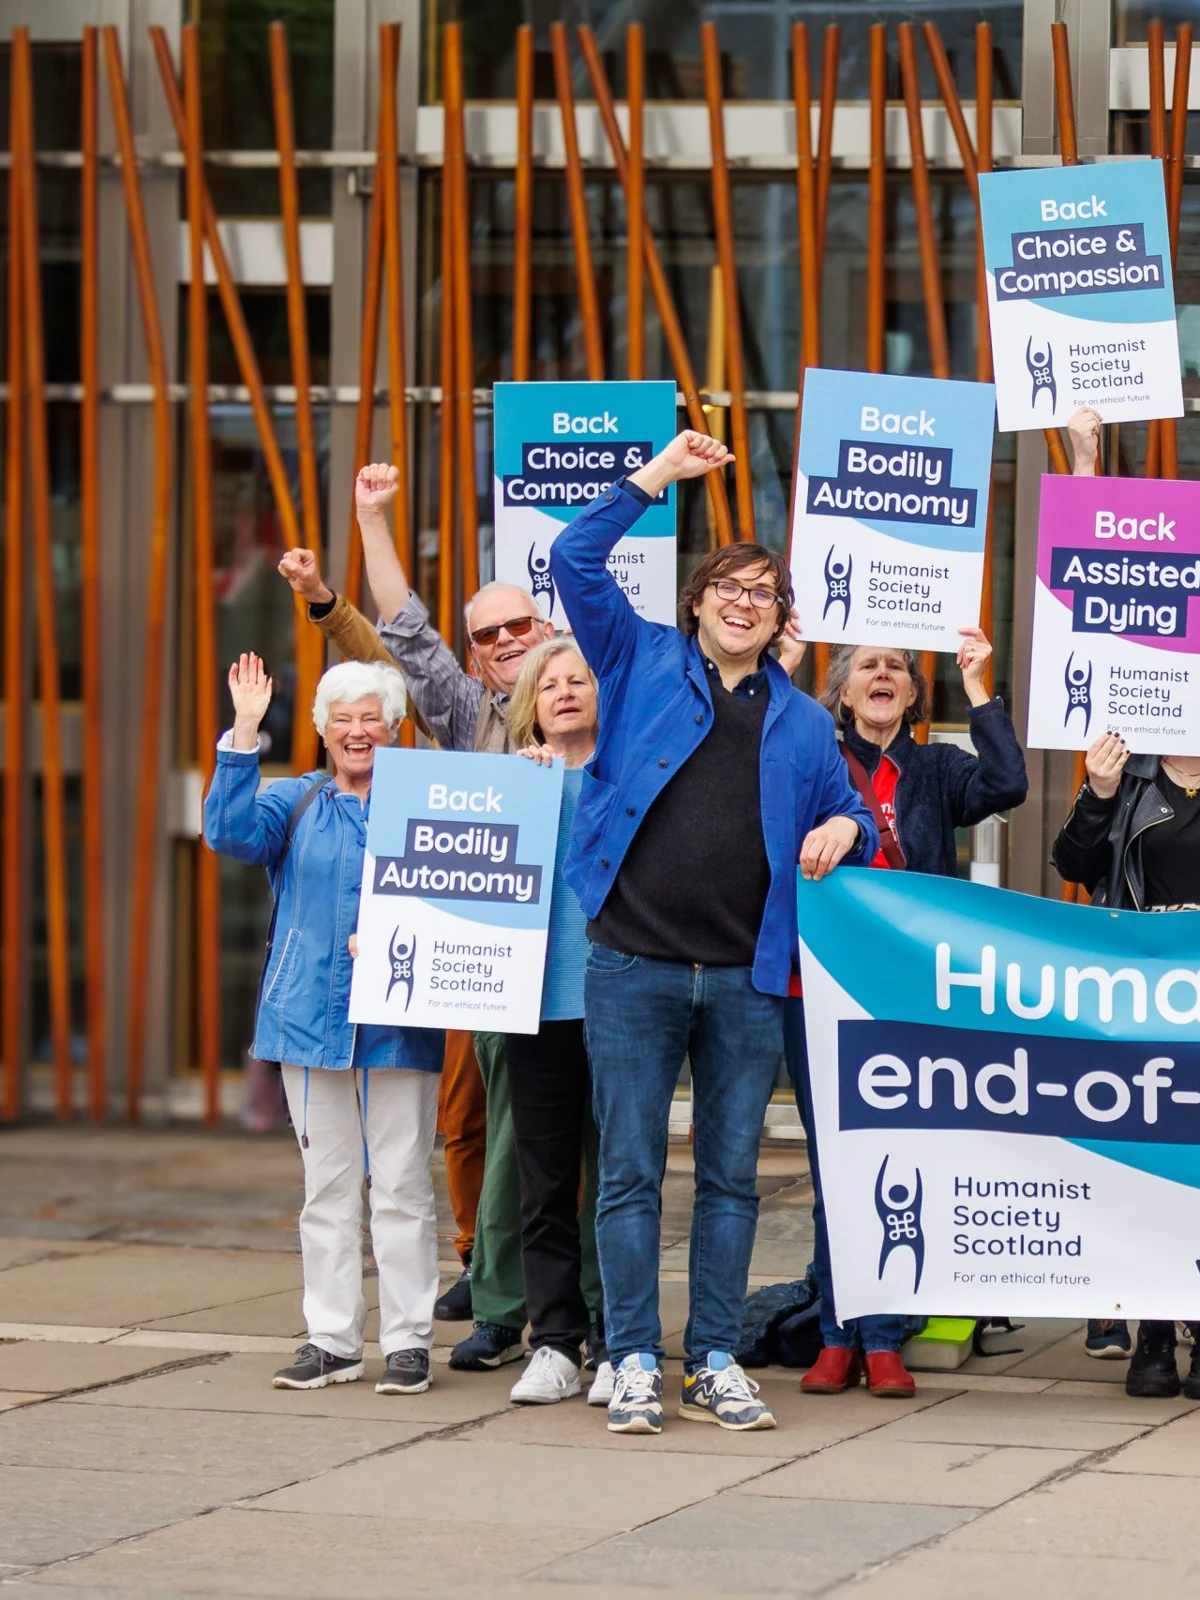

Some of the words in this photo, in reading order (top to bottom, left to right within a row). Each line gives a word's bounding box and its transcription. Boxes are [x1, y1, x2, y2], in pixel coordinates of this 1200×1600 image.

[1040, 195, 1108, 221] Back
[1017, 234, 1107, 260] Choice
[1115, 229, 1137, 251] &
[999, 262, 1159, 294] Compassion
[1069, 339, 1146, 356] Humanist
[1070, 357, 1130, 373] Society
[1072, 372, 1144, 389] Scotland
[1100, 396, 1125, 404] ethical
[553, 411, 619, 434] Back
[860, 406, 936, 437] Back
[527, 447, 615, 470] Choice
[623, 447, 644, 468] &
[847, 447, 942, 485] Bodily
[813, 481, 969, 524] Autonomy
[1095, 511, 1176, 541] Back
[607, 552, 645, 564] anist
[870, 560, 949, 579] Humanist
[1063, 555, 1200, 588] Assisted
[868, 578, 930, 598] Society
[867, 596, 942, 614] Scotland
[866, 618, 879, 626] For
[894, 621, 919, 629] ethical
[921, 623, 946, 631] future
[1085, 597, 1177, 634] Dying
[1110, 666, 1189, 682] Humanist
[1109, 684, 1170, 702] Society
[1108, 702, 1182, 717] Scotland
[1134, 726, 1160, 734] ethical
[428, 784, 503, 813] Back
[414, 825, 508, 863] Bodily
[379, 861, 533, 902] Autonomy
[434, 940, 512, 957] Humanist
[431, 958, 493, 977] Society
[430, 976, 503, 993] Scotland
[455, 1002, 481, 1010] ethical
[483, 1003, 507, 1011] future
[953, 1176, 1092, 1200] Humanist
[952, 1205, 1061, 1231] Society
[952, 1233, 1082, 1256] Scotland
[953, 1271, 971, 1283] For
[979, 1274, 995, 1284] an
[1002, 1271, 1043, 1285] ethical
[1048, 1272, 1091, 1285] future
